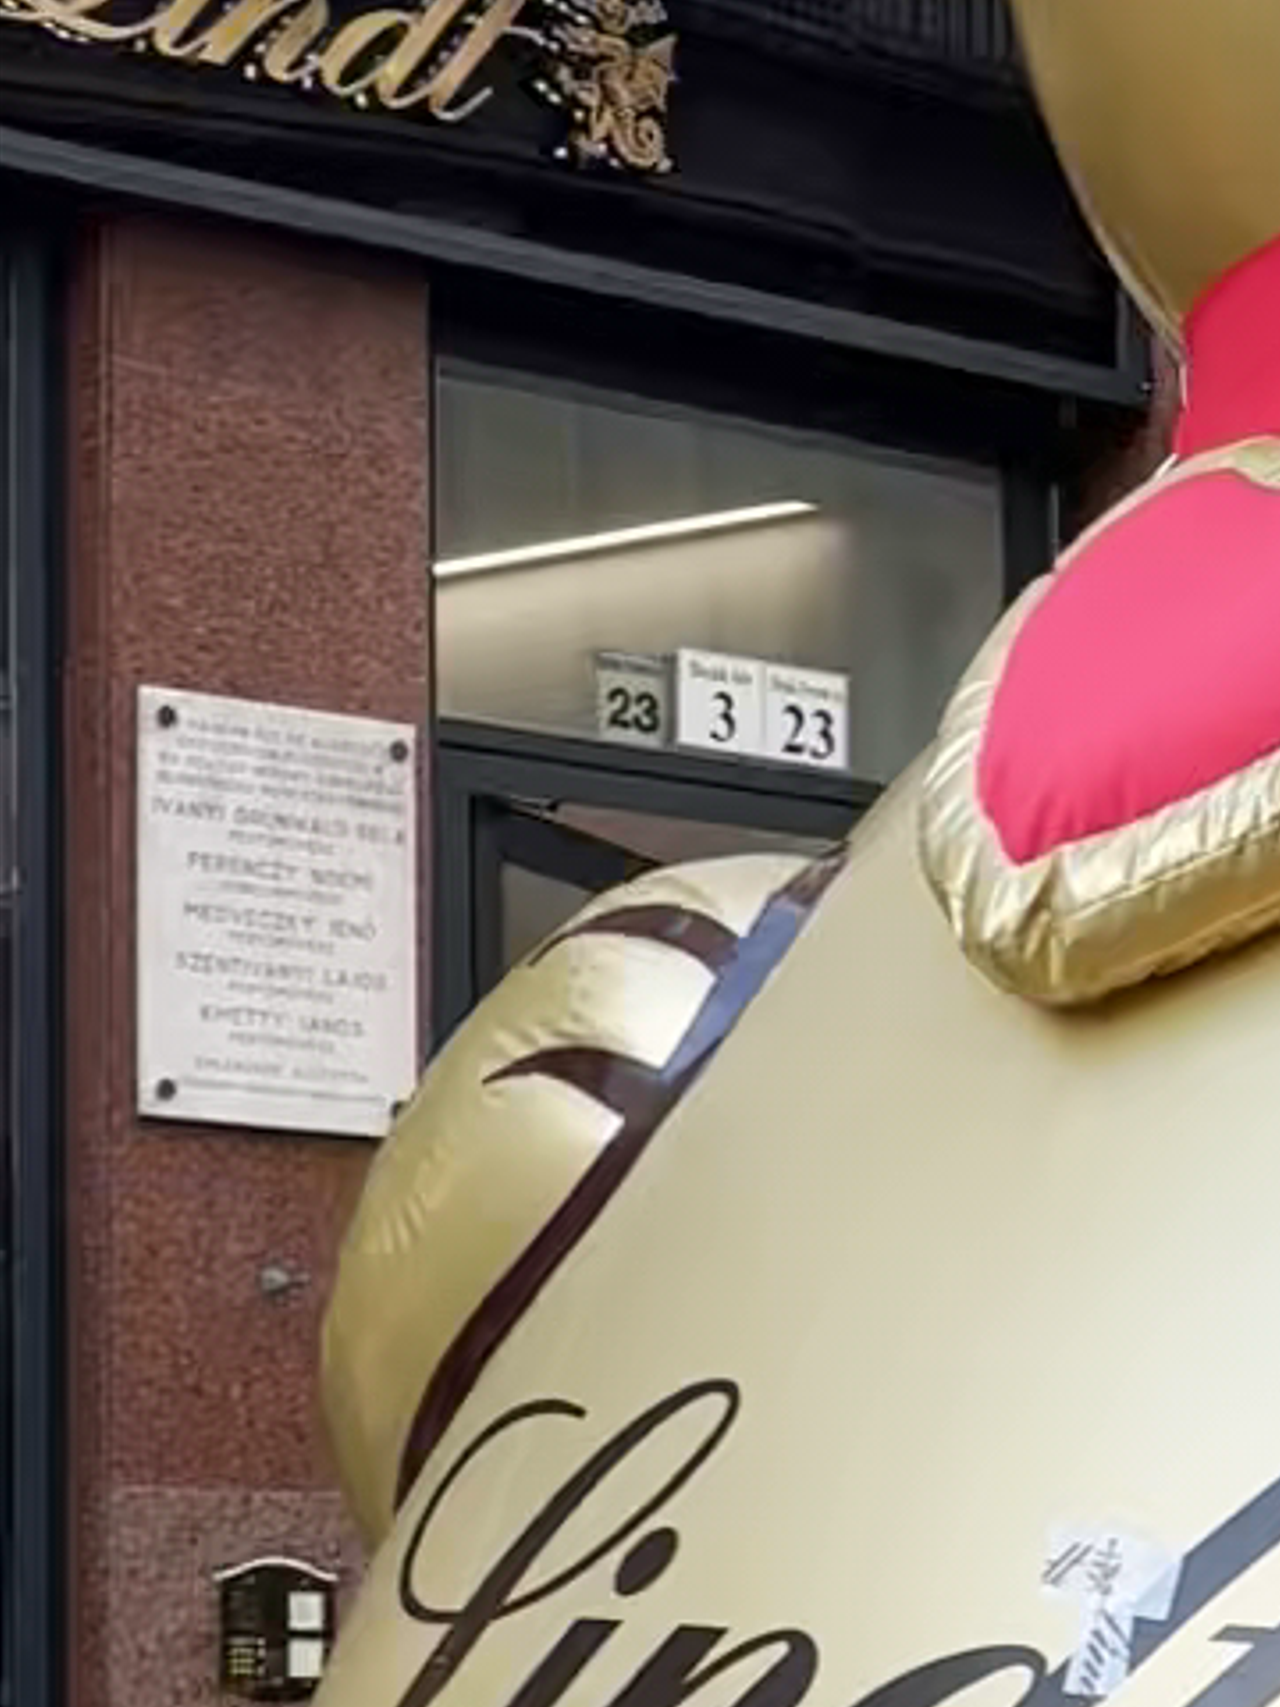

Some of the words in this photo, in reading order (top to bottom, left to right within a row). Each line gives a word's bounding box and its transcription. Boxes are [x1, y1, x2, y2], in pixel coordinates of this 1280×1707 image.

[606, 686, 660, 734] 23
[708, 690, 737, 743] 3
[780, 704, 836, 760] 23
